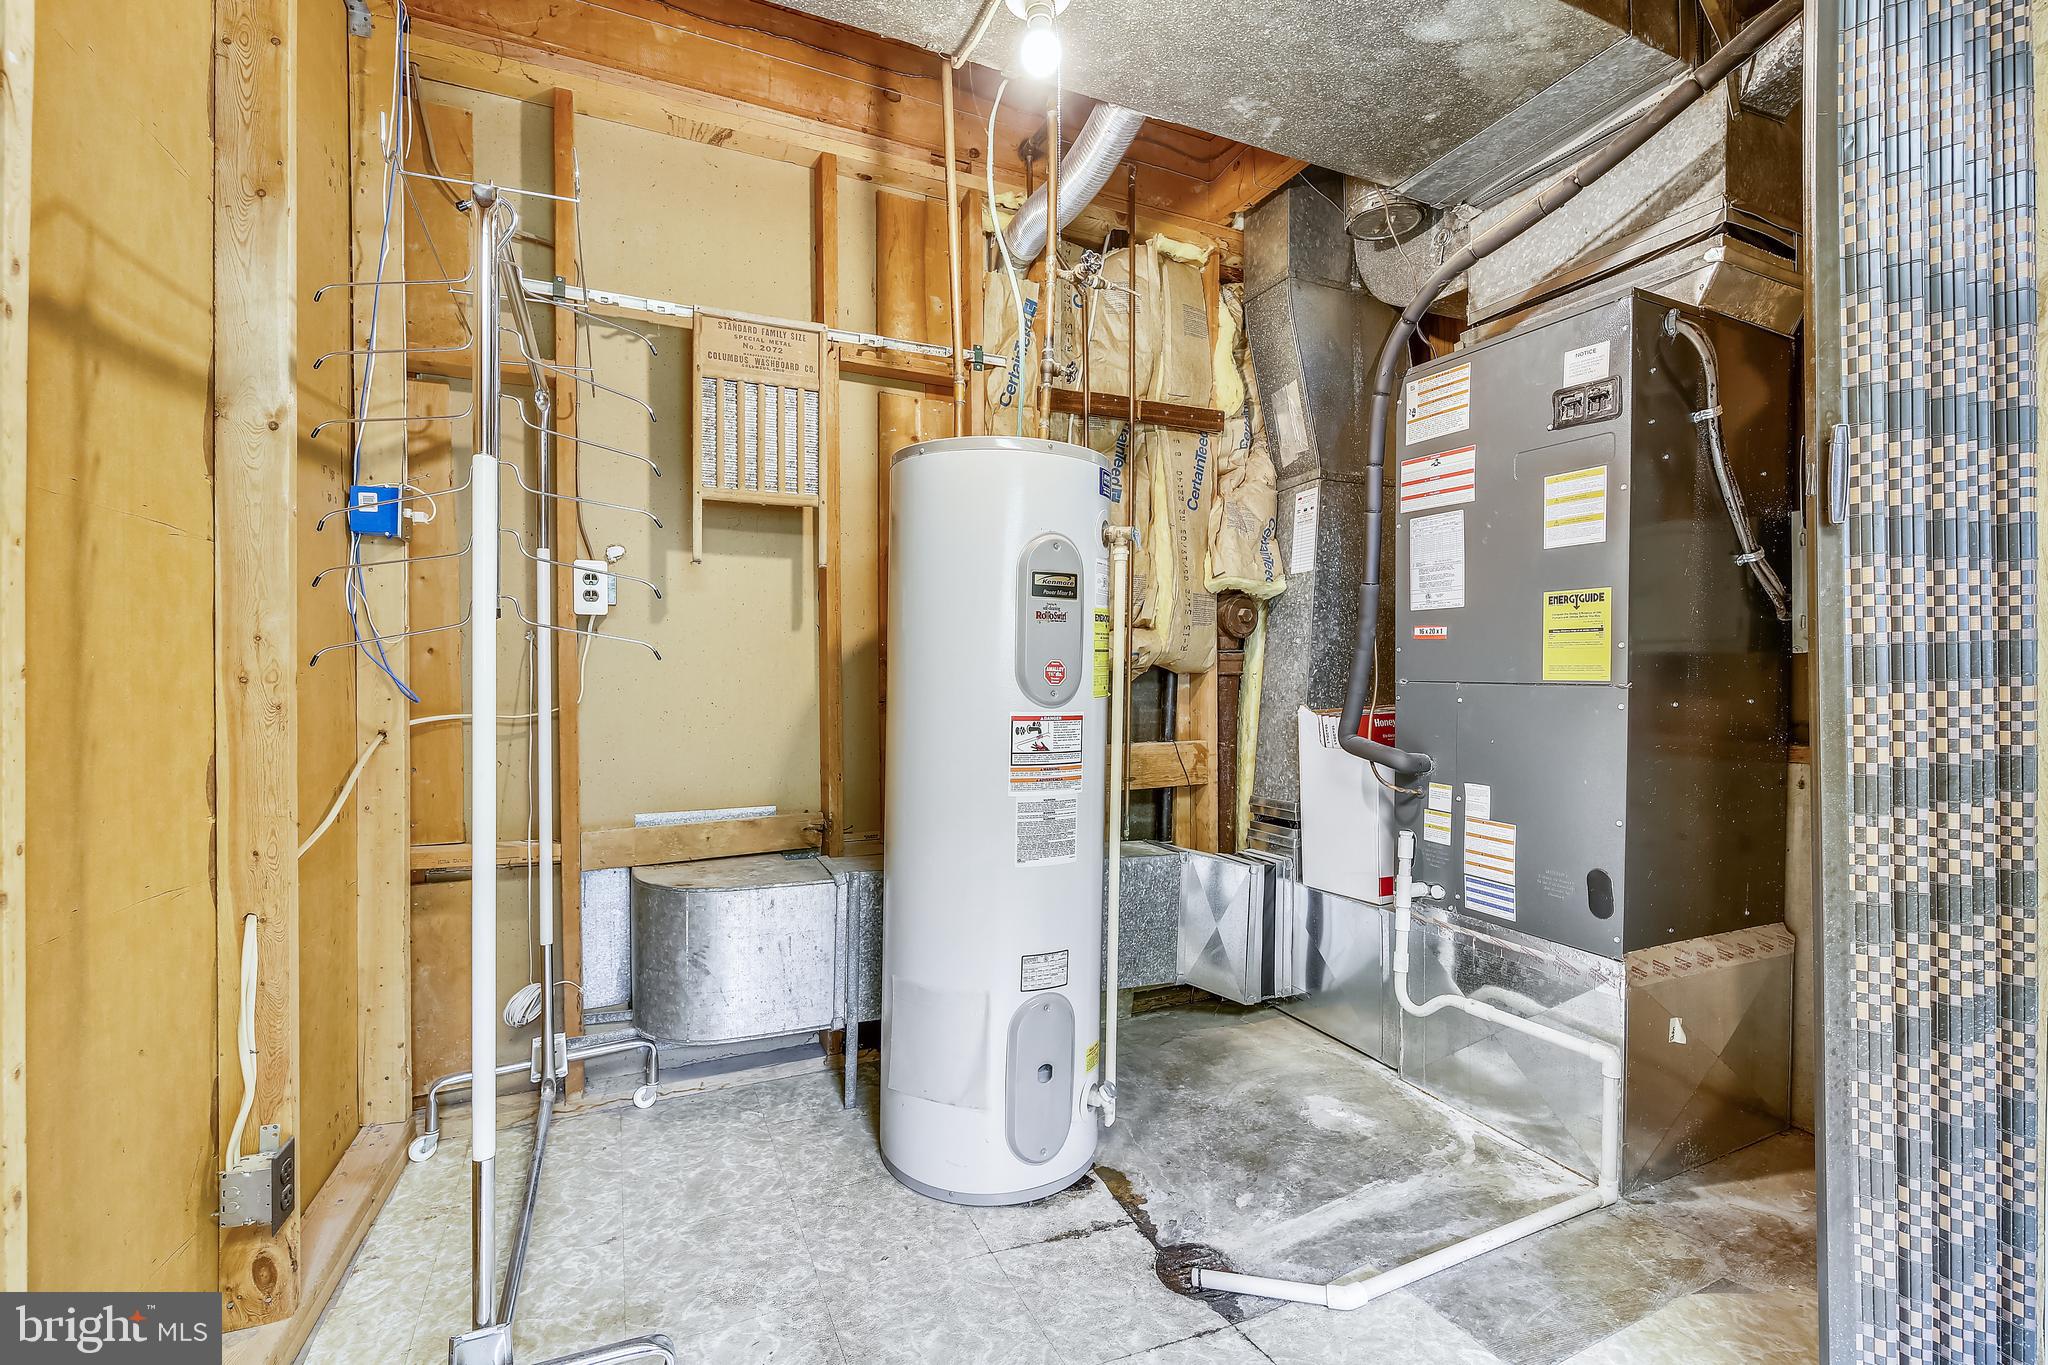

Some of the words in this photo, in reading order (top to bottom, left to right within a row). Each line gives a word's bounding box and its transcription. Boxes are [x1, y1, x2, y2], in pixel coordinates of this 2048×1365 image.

[718, 321, 758, 335] STANDARD
[761, 328, 787, 339] FAMILY
[791, 332, 807, 342] SIZE
[734, 334, 765, 343] SPECIAL
[769, 339, 792, 347] METAL
[743, 342, 757, 350] No.
[760, 344, 783, 354] 2072
[1575, 348, 1597, 358] NOTICE
[707, 351, 749, 363] COLUMBUS
[755, 357, 799, 371] WASHBOARD
[805, 365, 816, 373] CO.
[1548, 592, 1605, 606] ENERGYGUIDE
